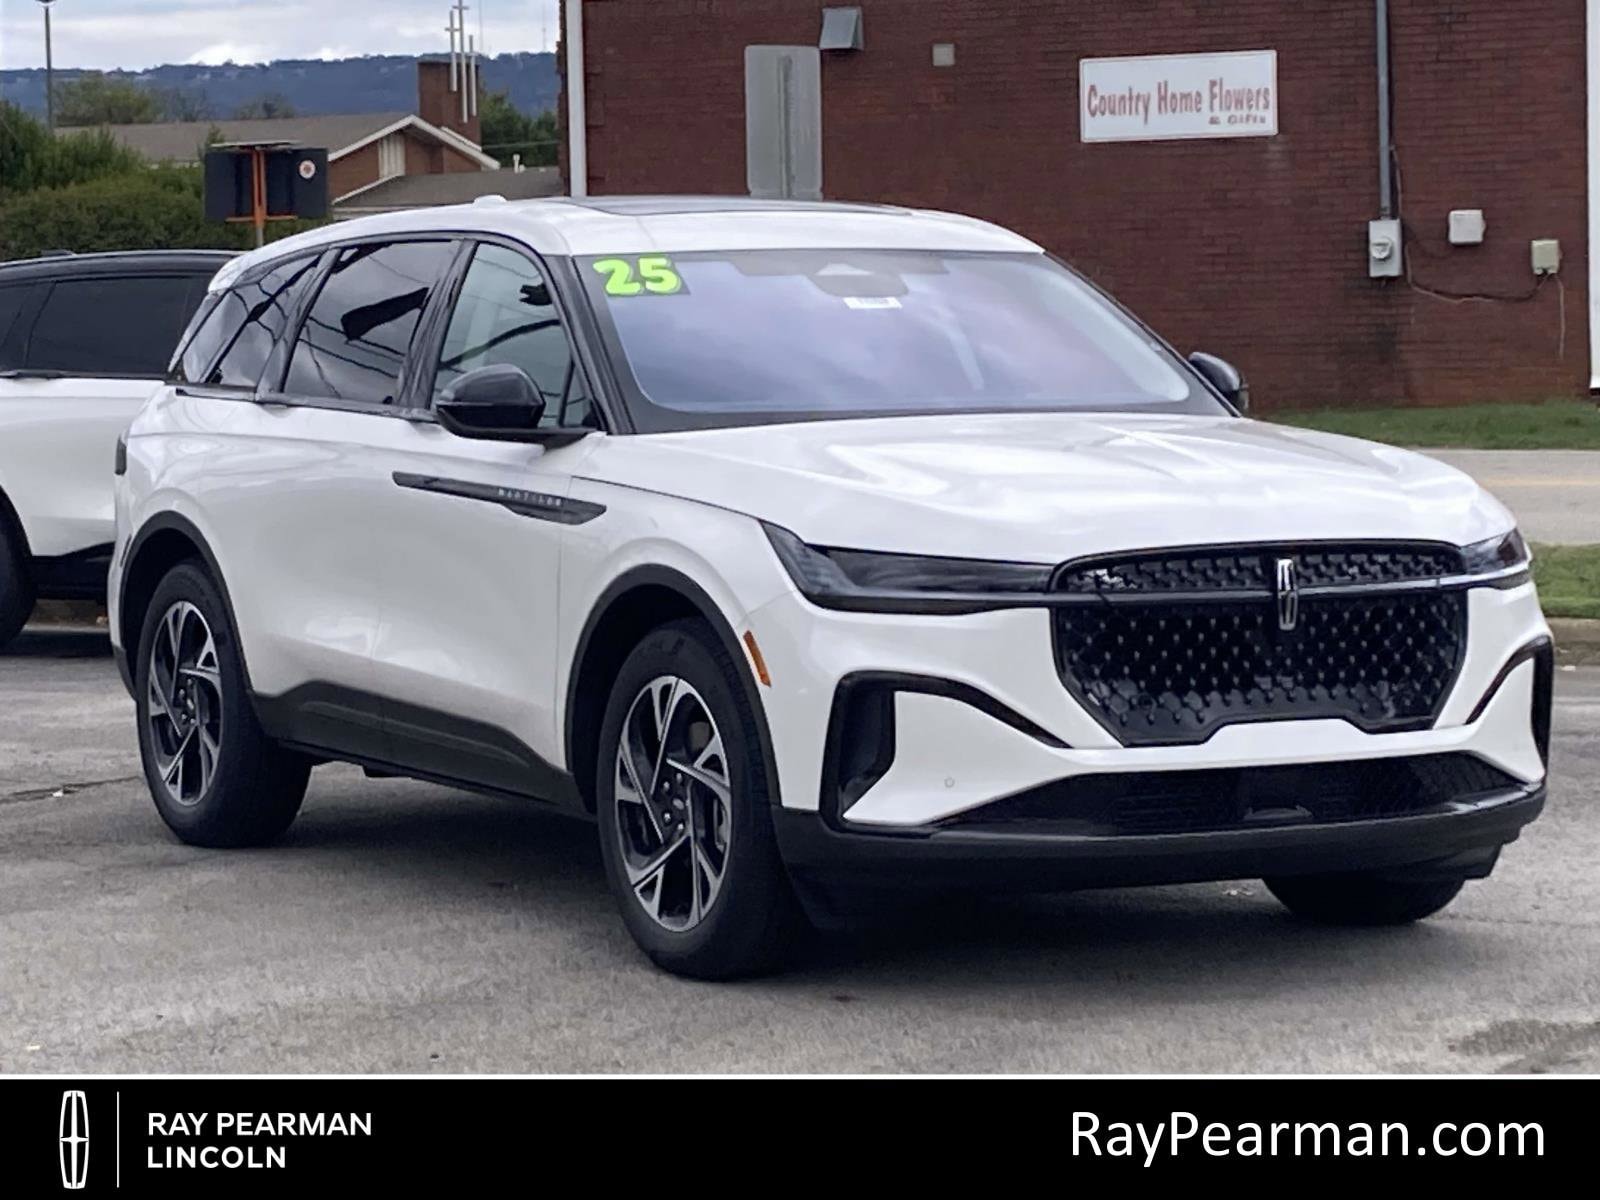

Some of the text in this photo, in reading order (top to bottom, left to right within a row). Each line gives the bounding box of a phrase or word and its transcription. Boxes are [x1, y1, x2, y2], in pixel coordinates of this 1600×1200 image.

[1087, 77, 1270, 125] Country Home Flowers
[592, 255, 682, 297] 25
